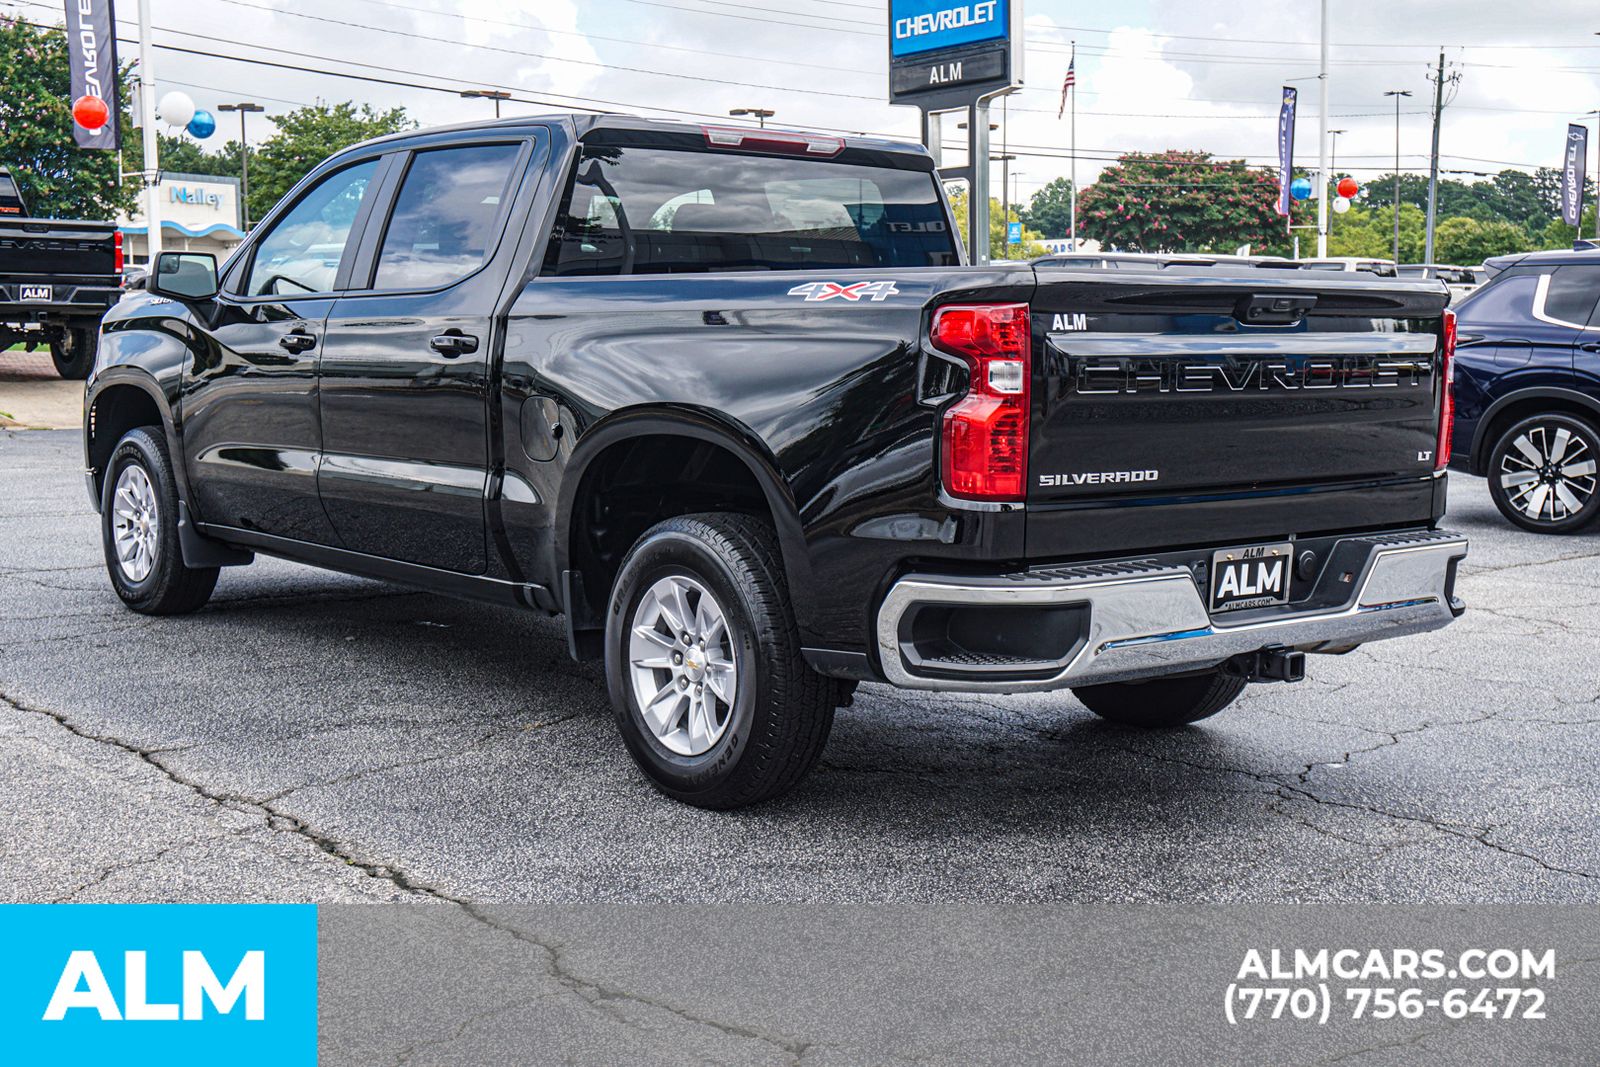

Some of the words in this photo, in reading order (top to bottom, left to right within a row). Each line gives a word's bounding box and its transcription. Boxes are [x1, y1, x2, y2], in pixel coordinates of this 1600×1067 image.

[896, 1, 997, 39] CHEVROLET
[929, 62, 962, 84] ALM
[169, 186, 225, 211] Nalley
[23, 289, 49, 298] ALM
[1052, 313, 1087, 331] ALM
[1076, 358, 1430, 394] CHEVROLET
[1417, 451, 1432, 462] LT
[1039, 470, 1159, 486] SILVERADO
[1242, 547, 1265, 559] ALM
[1217, 560, 1283, 599] ALM
